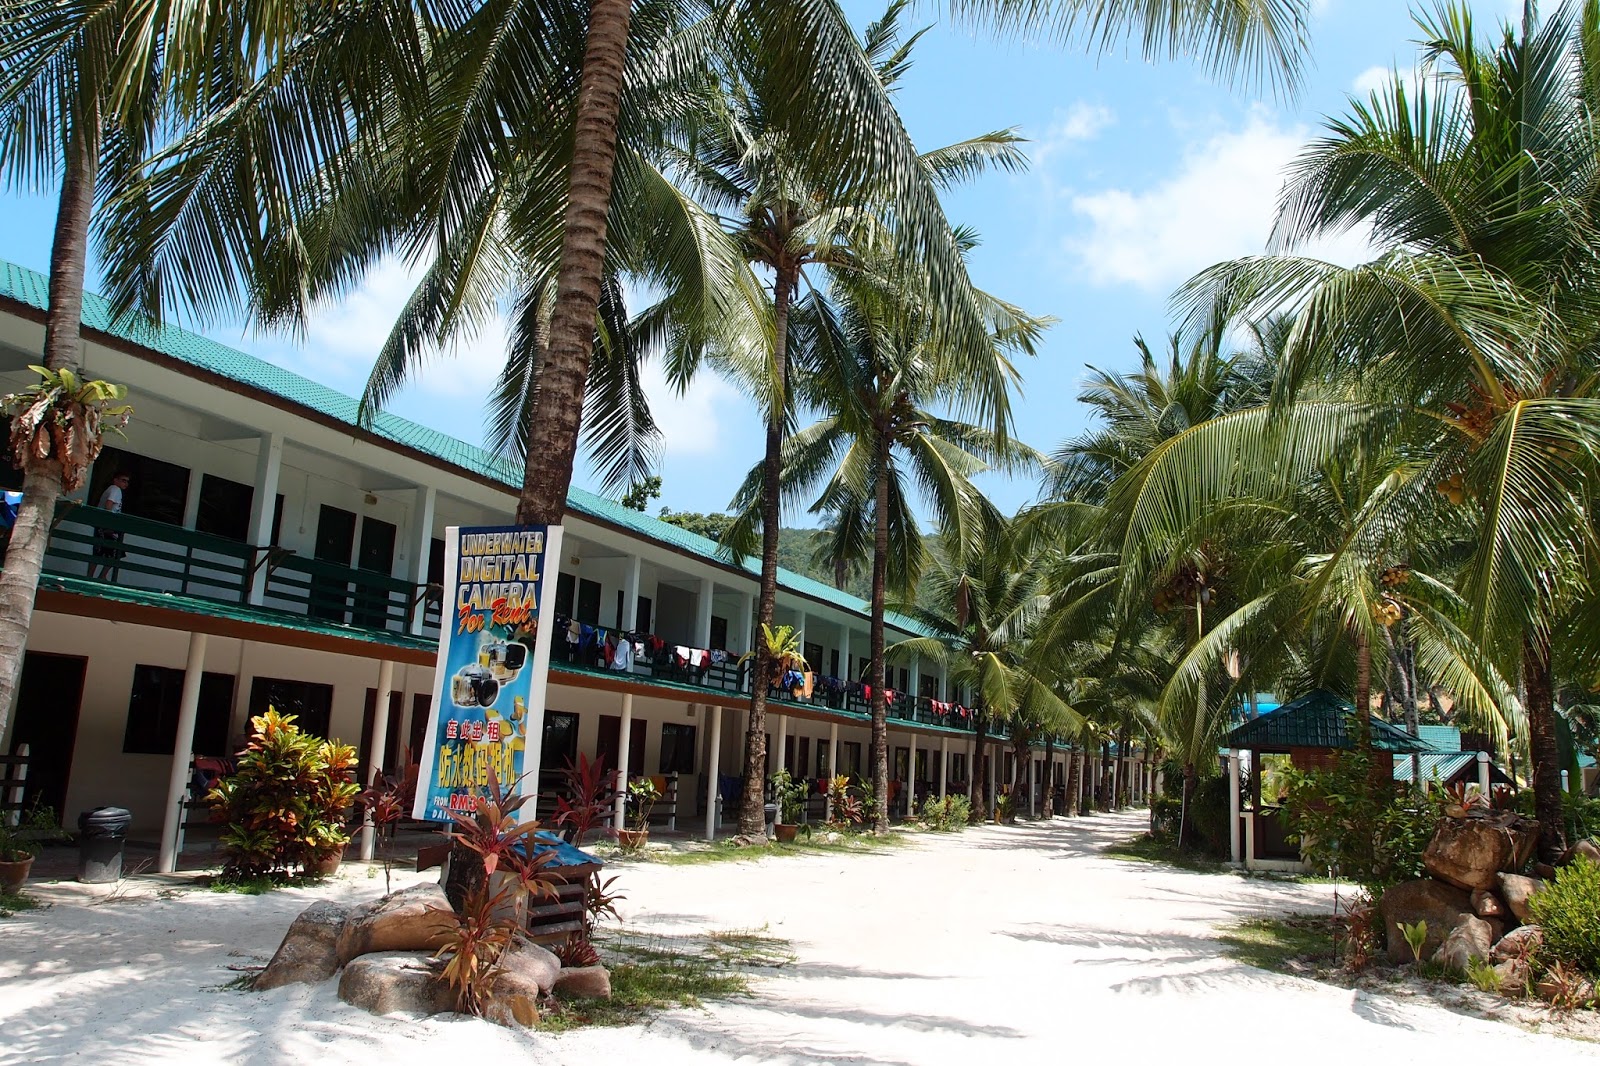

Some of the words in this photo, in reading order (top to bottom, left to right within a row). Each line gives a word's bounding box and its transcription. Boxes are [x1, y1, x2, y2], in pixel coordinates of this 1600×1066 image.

[461, 532, 544, 556] UNDERWATER
[460, 554, 540, 583] DIGITAL
[457, 582, 537, 610] CAMERA
[458, 605, 485, 635] For
[489, 597, 531, 629] Rent
[446, 718, 500, 741] 在此出租
[438, 742, 515, 788] 防水数码相机
